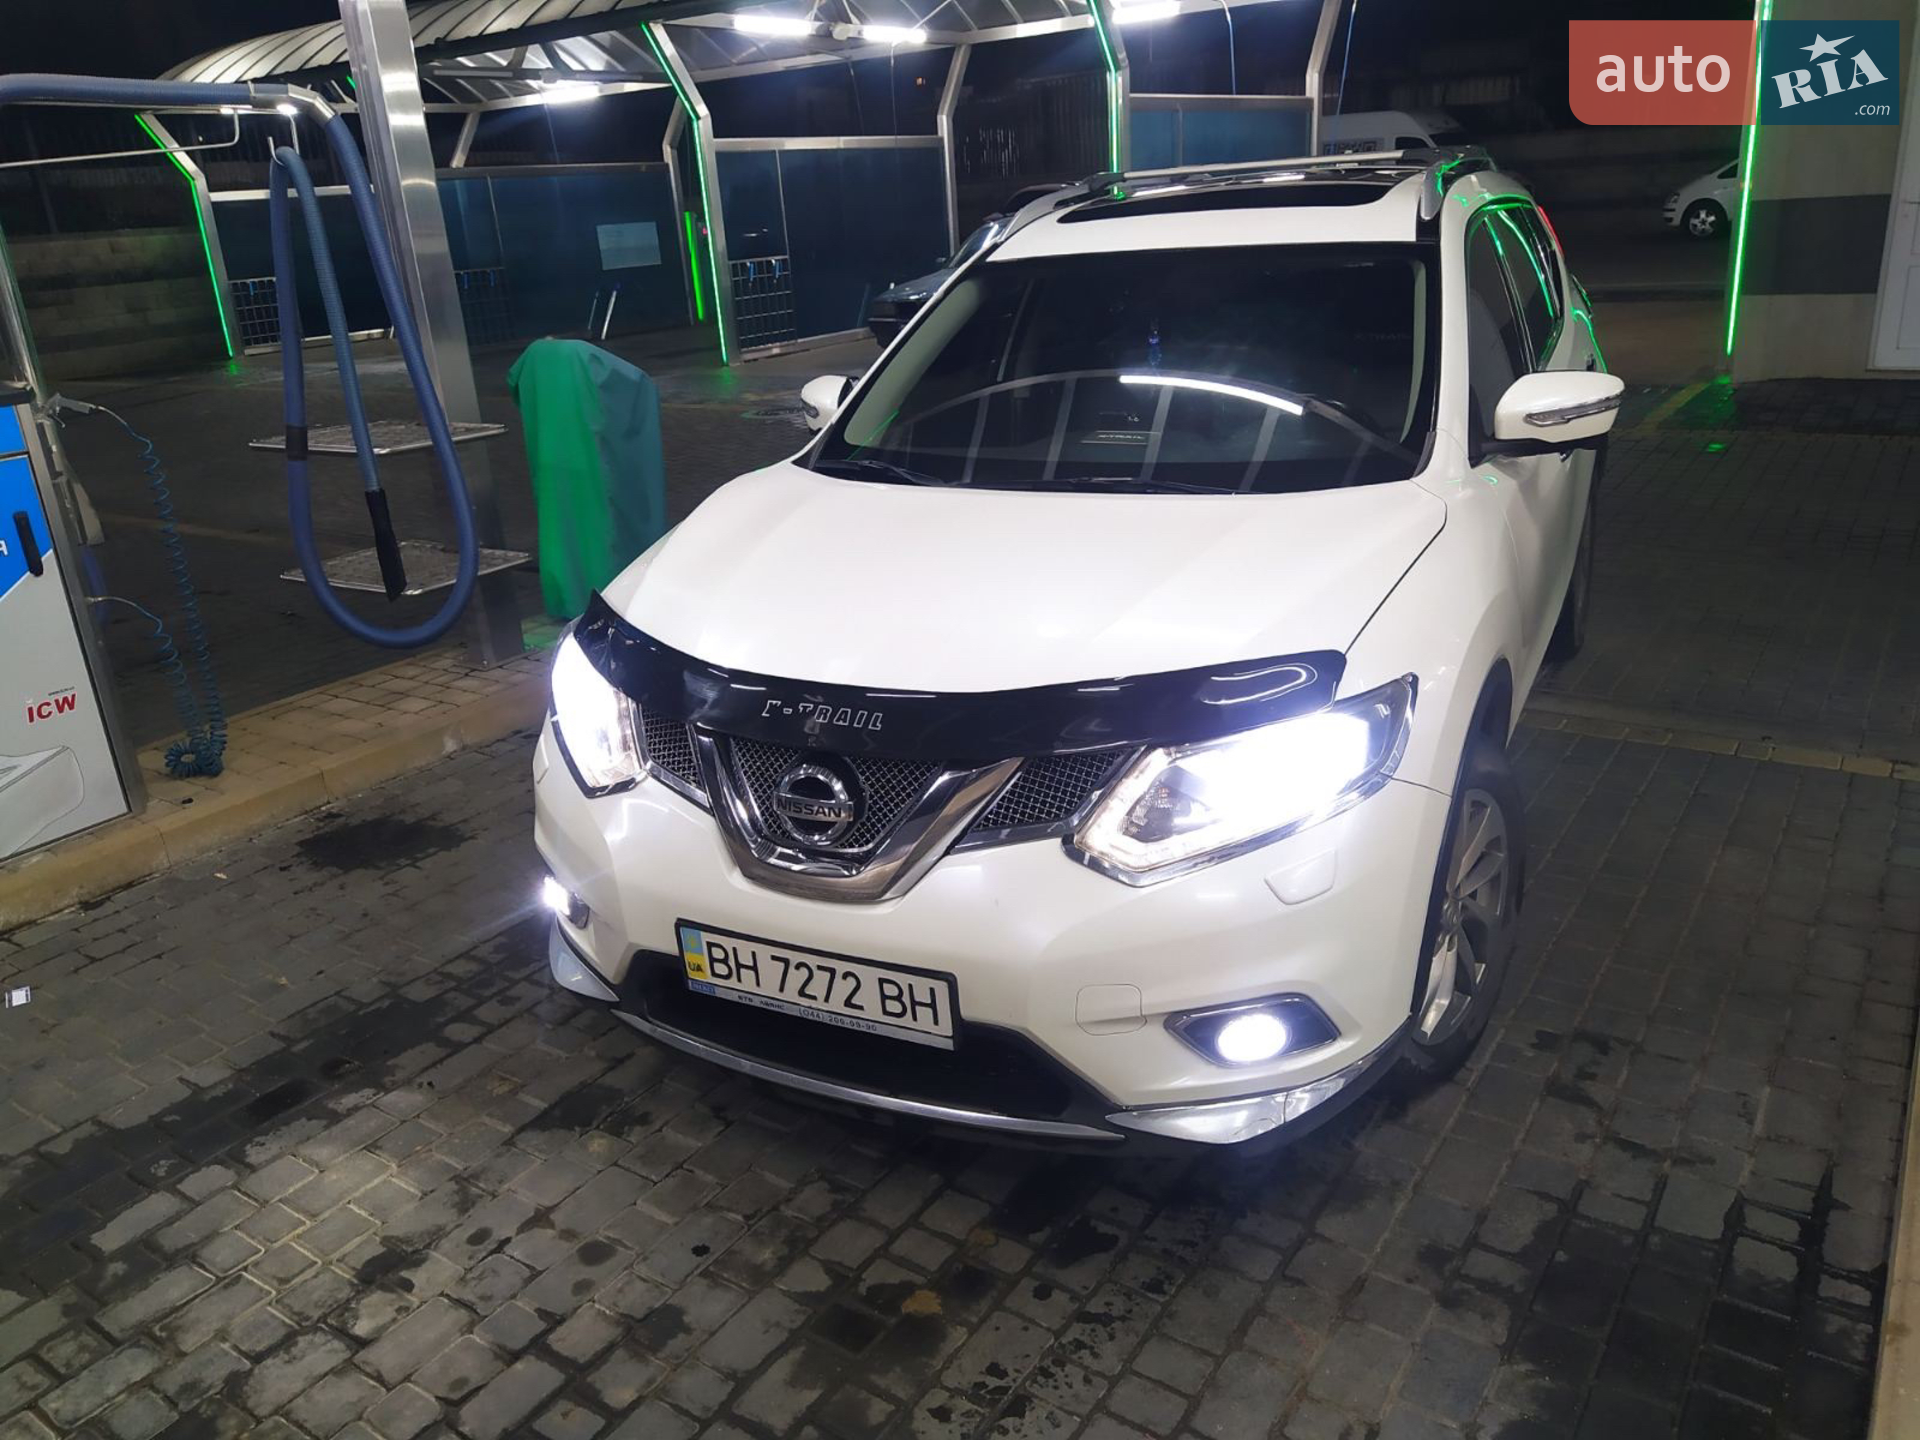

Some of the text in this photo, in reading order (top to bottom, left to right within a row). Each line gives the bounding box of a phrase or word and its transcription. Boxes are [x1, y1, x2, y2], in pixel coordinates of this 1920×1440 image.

[776, 800, 842, 818] NISSAN
[687, 960, 704, 973] UA
[706, 941, 940, 1026] BH 7272 BH
